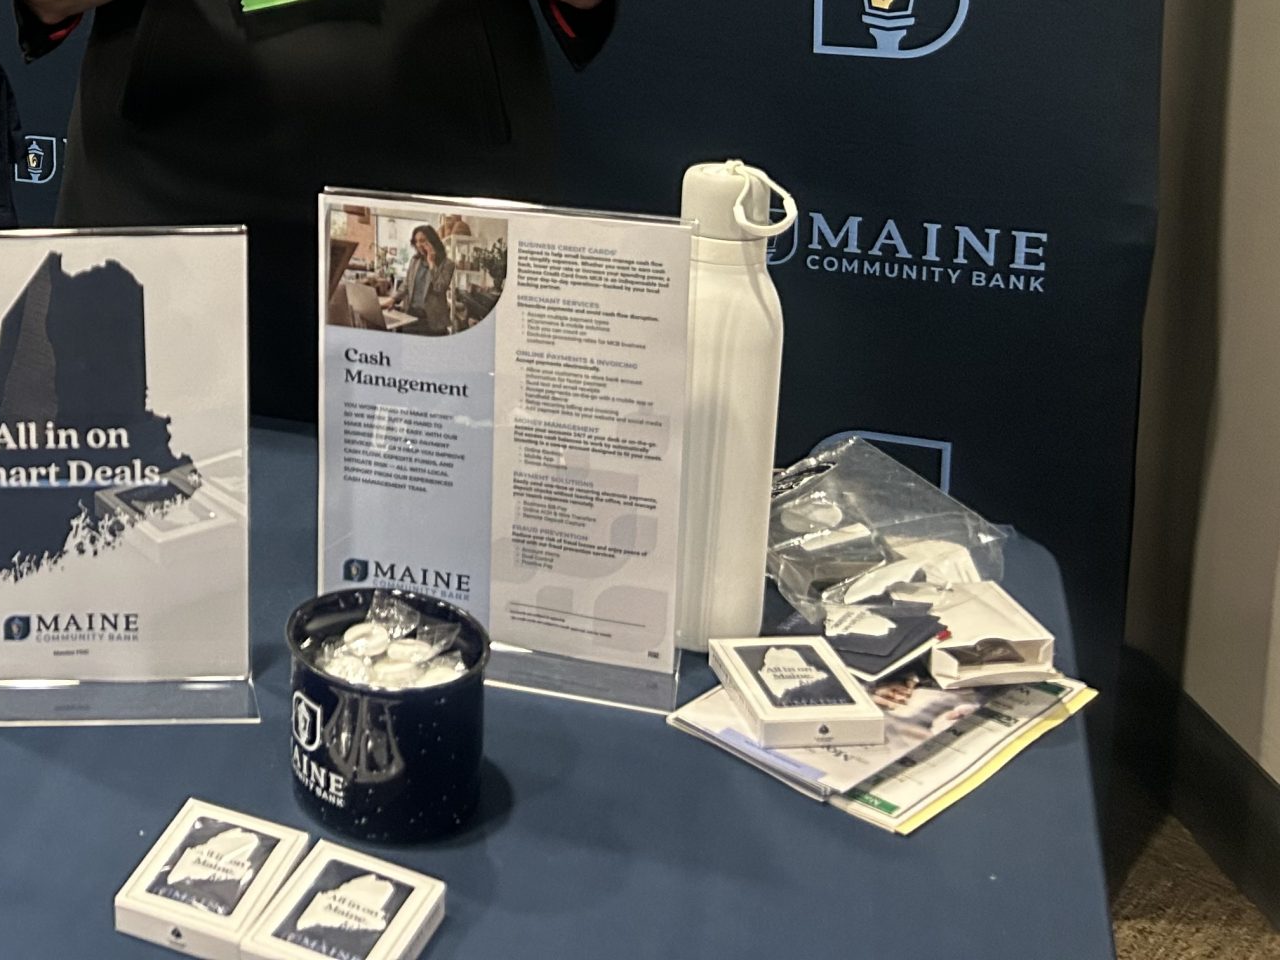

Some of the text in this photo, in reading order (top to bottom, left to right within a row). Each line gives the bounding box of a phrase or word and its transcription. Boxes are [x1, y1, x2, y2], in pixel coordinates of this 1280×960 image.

[518, 240, 555, 251] BUSINESS
[558, 244, 586, 253] CREDIT
[808, 211, 1047, 272] MAINE
[806, 254, 1045, 293] COMMUNITY BANK
[517, 295, 599, 308] MERCHANT SERVICES
[344, 348, 391, 367] Cash
[344, 368, 469, 397] Management
[46, 421, 80, 449] in
[86, 426, 129, 448] on
[68, 460, 169, 487] Deals.
[373, 561, 470, 592] MAINE
[441, 590, 470, 601] BANK
[36, 613, 139, 632] MAINE
[36, 632, 139, 642] COMMUNITY BANK
[292, 743, 344, 797] AINE
[315, 784, 345, 808] BANK
